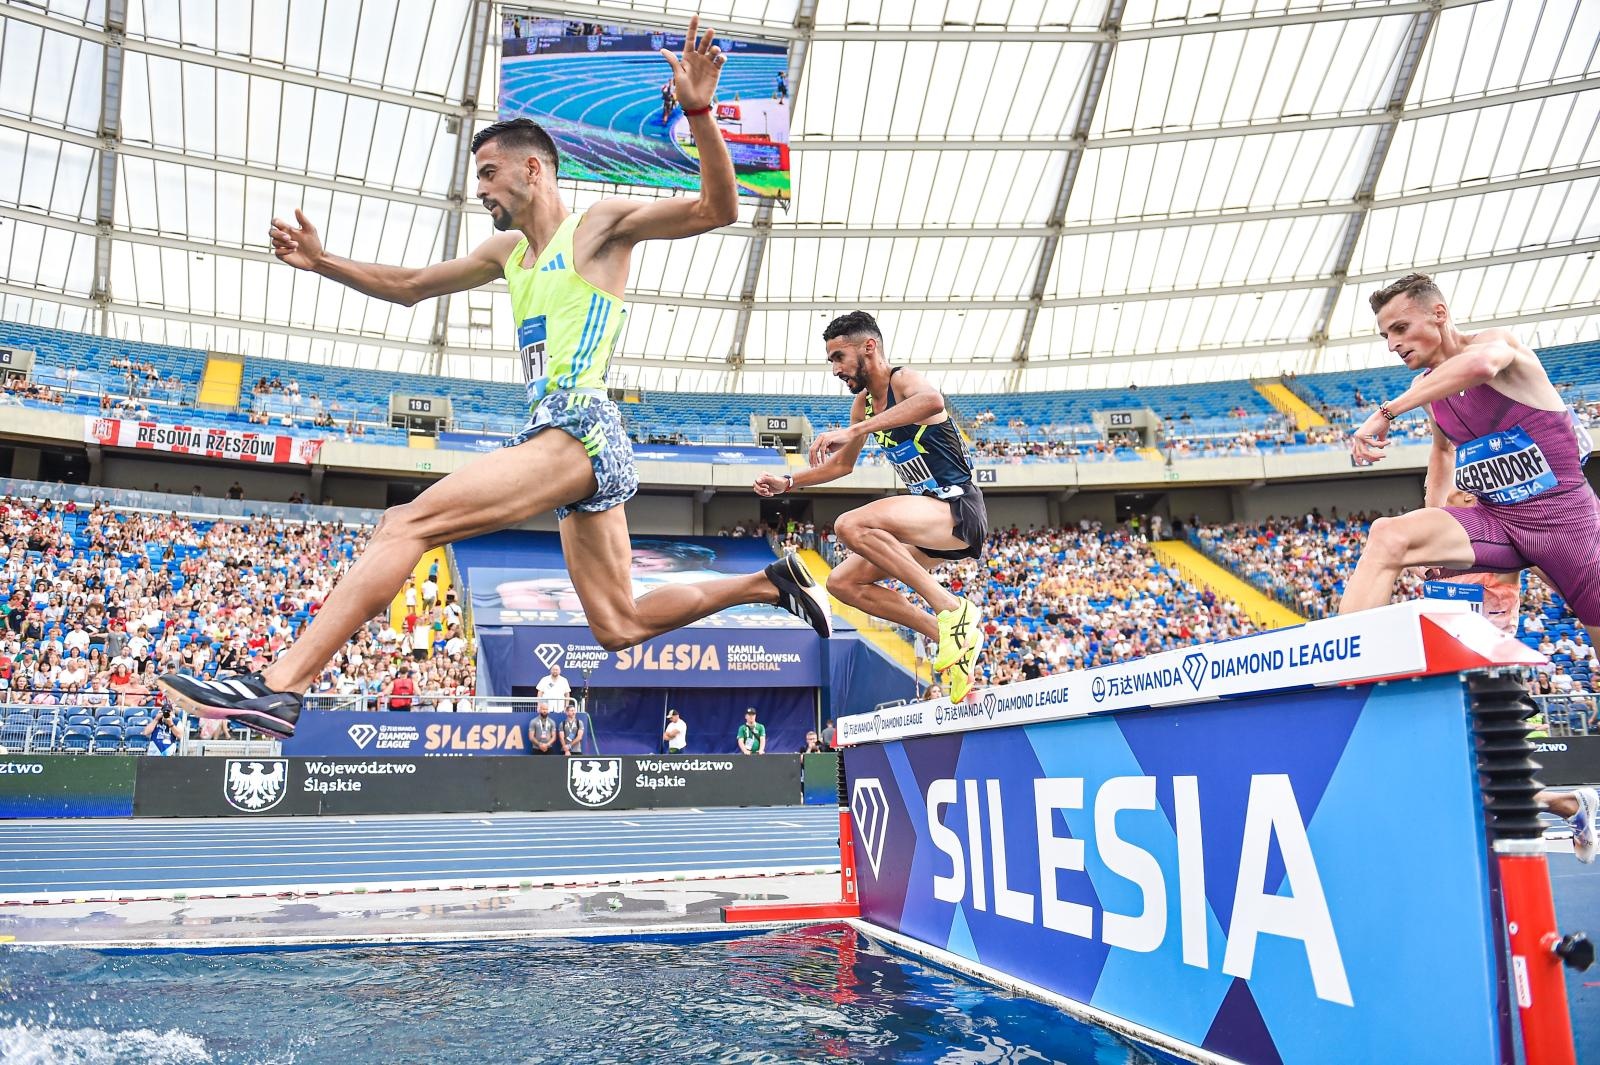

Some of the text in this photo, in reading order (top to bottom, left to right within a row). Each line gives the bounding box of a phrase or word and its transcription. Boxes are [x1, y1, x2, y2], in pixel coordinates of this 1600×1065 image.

[410, 400, 420, 410] 19
[768, 419, 779, 429] 20
[1112, 415, 1122, 424] 21
[138, 427, 275, 456] RESOVIA RZESZÓW
[980, 471, 992, 481] 21
[1488, 481, 1544, 503] SILESIA
[565, 652, 608, 660] DIAMOND
[727, 645, 765, 654] KAMILA
[564, 660, 599, 669] LEAGUE
[615, 644, 721, 671] SILESIA
[727, 653, 801, 662] SKOLIMOWSKA
[1210, 649, 1283, 680] DIAMOND
[1289, 635, 1361, 667] LEAGUE
[727, 662, 781, 671] MEMORIAL
[997, 693, 1034, 713] DIAMOND
[1035, 687, 1069, 707] LEAGUE
[881, 716, 902, 730] DIAMOND
[903, 712, 923, 726] LEAGUE
[378, 732, 419, 741] DIAMOND
[424, 724, 524, 750] SILESIA
[376, 740, 410, 749] LEAGUE
[304, 761, 417, 777] Województwo
[635, 759, 734, 774] Województwo
[303, 777, 362, 795] Śląskie
[635, 774, 686, 790] Śląskie
[926, 773, 1355, 1008] SILESIA
